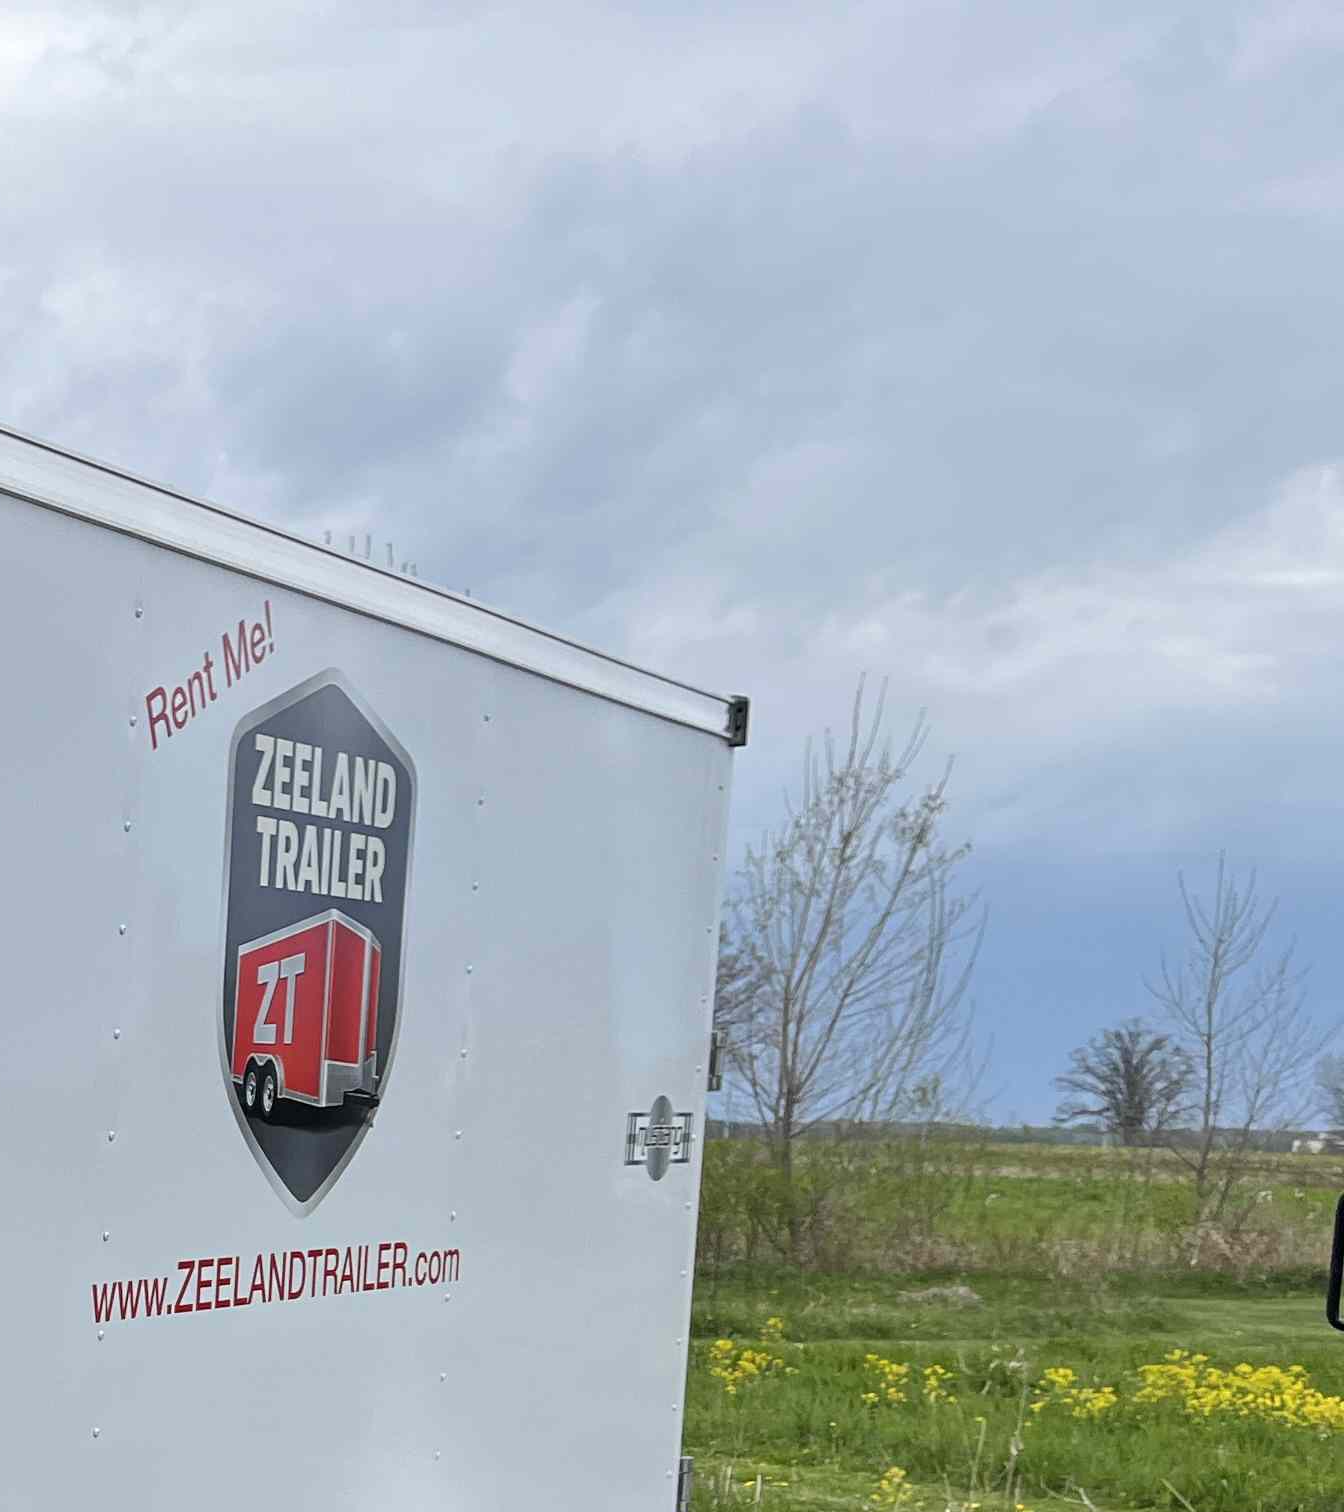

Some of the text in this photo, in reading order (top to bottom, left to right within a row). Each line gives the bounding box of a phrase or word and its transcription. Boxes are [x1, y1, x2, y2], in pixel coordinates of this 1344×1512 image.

[145, 600, 275, 751] Rent Me!
[252, 733, 397, 829] ZEELAND
[256, 816, 386, 903] TRAILER
[253, 952, 306, 1045] ZT
[92, 1242, 461, 1323] www.ZEELANDTRAILER.com
